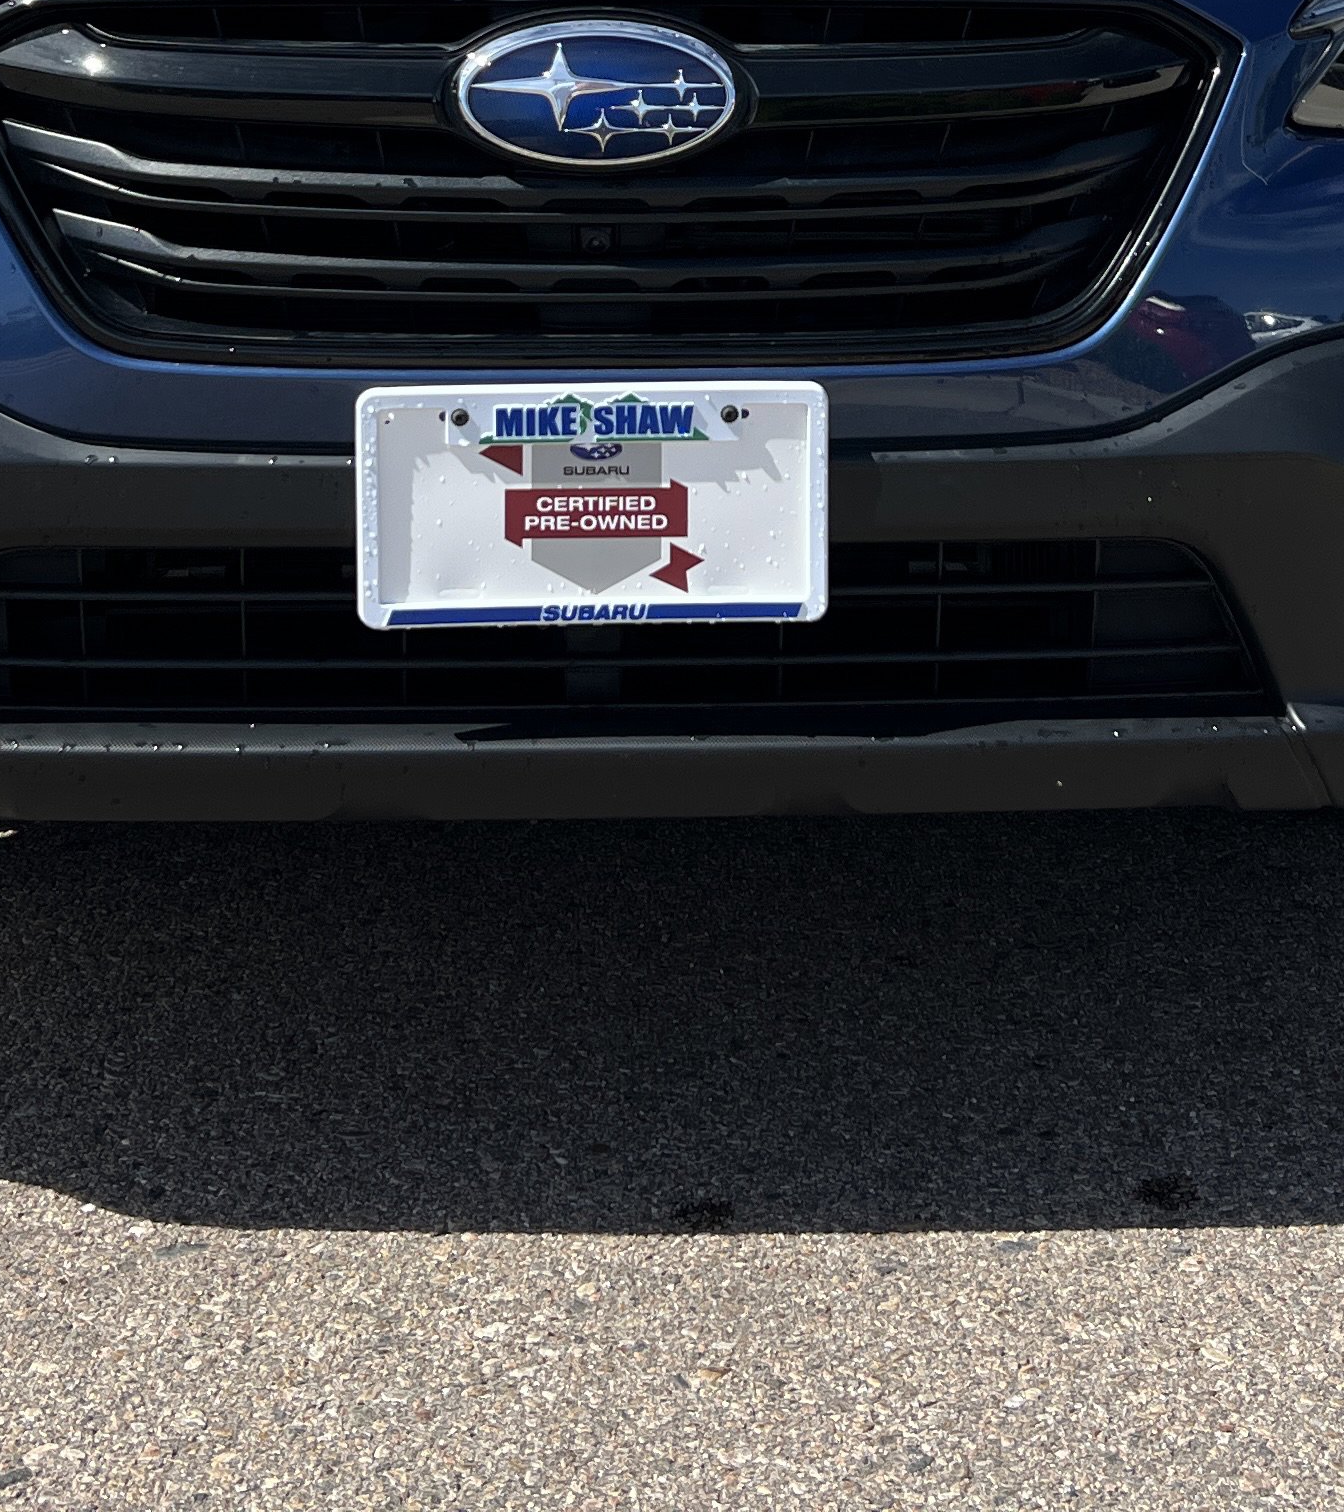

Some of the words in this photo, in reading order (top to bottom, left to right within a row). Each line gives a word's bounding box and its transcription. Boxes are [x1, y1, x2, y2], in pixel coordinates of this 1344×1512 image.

[495, 406, 578, 437] MIKE
[593, 404, 694, 435] SHAW
[563, 465, 630, 476] SUBARU
[536, 496, 656, 512] CERTIFIED
[524, 514, 668, 531] PRE-OWNED
[542, 604, 647, 622] SUBARU
